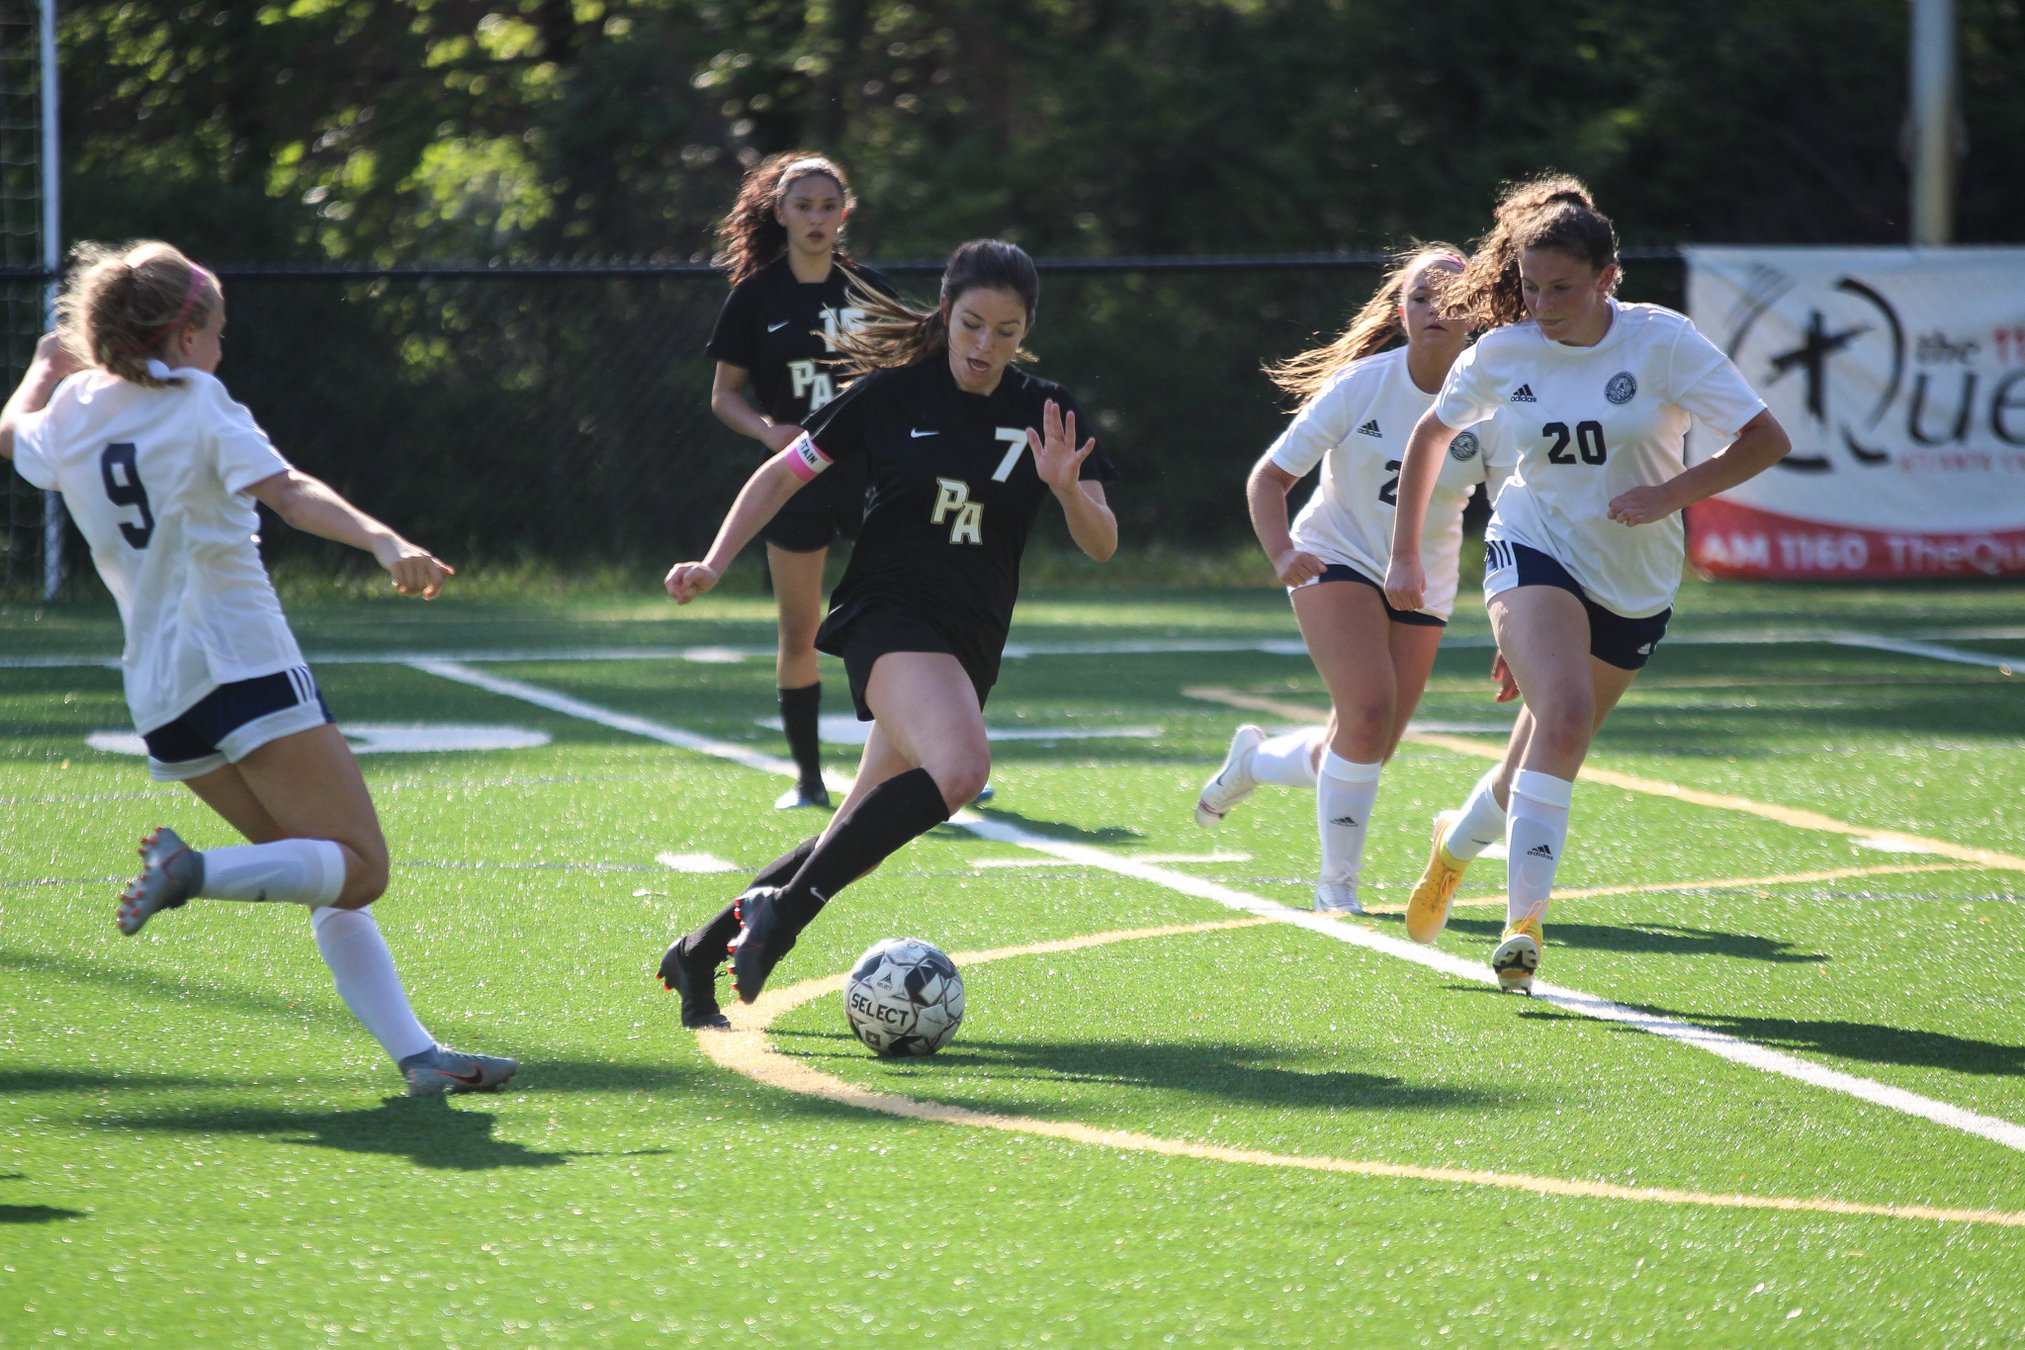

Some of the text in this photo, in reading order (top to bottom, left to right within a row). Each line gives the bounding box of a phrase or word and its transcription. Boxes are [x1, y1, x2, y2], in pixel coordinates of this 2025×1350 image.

[1916, 329, 1980, 364] the
[788, 360, 834, 411] PA
[991, 427, 1029, 483] 7
[1543, 420, 1607, 466] 20
[101, 442, 154, 550] 9
[930, 476, 984, 545] PA
[1703, 533, 1769, 569] AM
[1779, 533, 1868, 570] 1160
[851, 992, 909, 1027] SELECT
